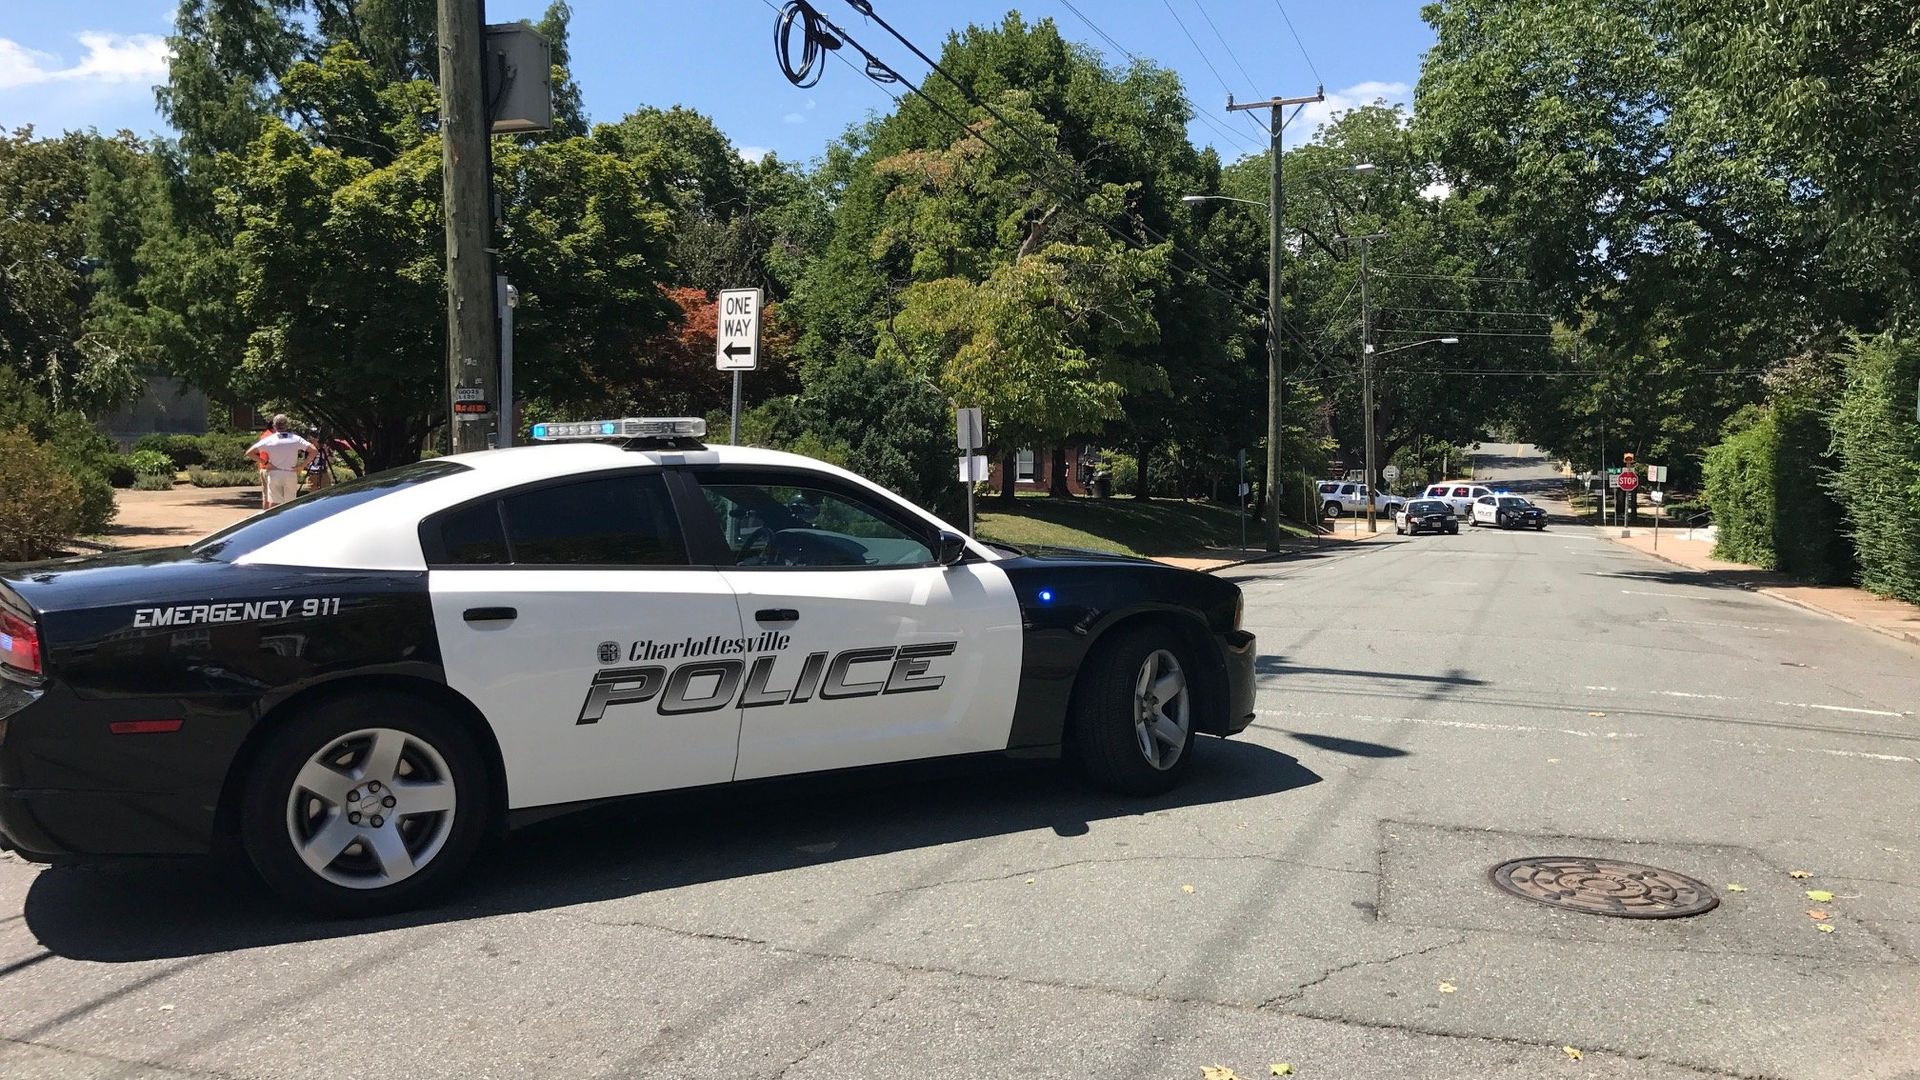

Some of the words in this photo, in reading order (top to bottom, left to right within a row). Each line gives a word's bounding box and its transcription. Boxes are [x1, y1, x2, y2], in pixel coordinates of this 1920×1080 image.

[726, 297, 752, 315] ONE
[724, 319, 752, 337] WAY
[1619, 476, 1637, 485] STOP
[133, 599, 294, 628] EMERGENCY
[301, 597, 341, 616] 911
[629, 631, 790, 662] Charlottesville
[576, 641, 958, 725] POLICE
